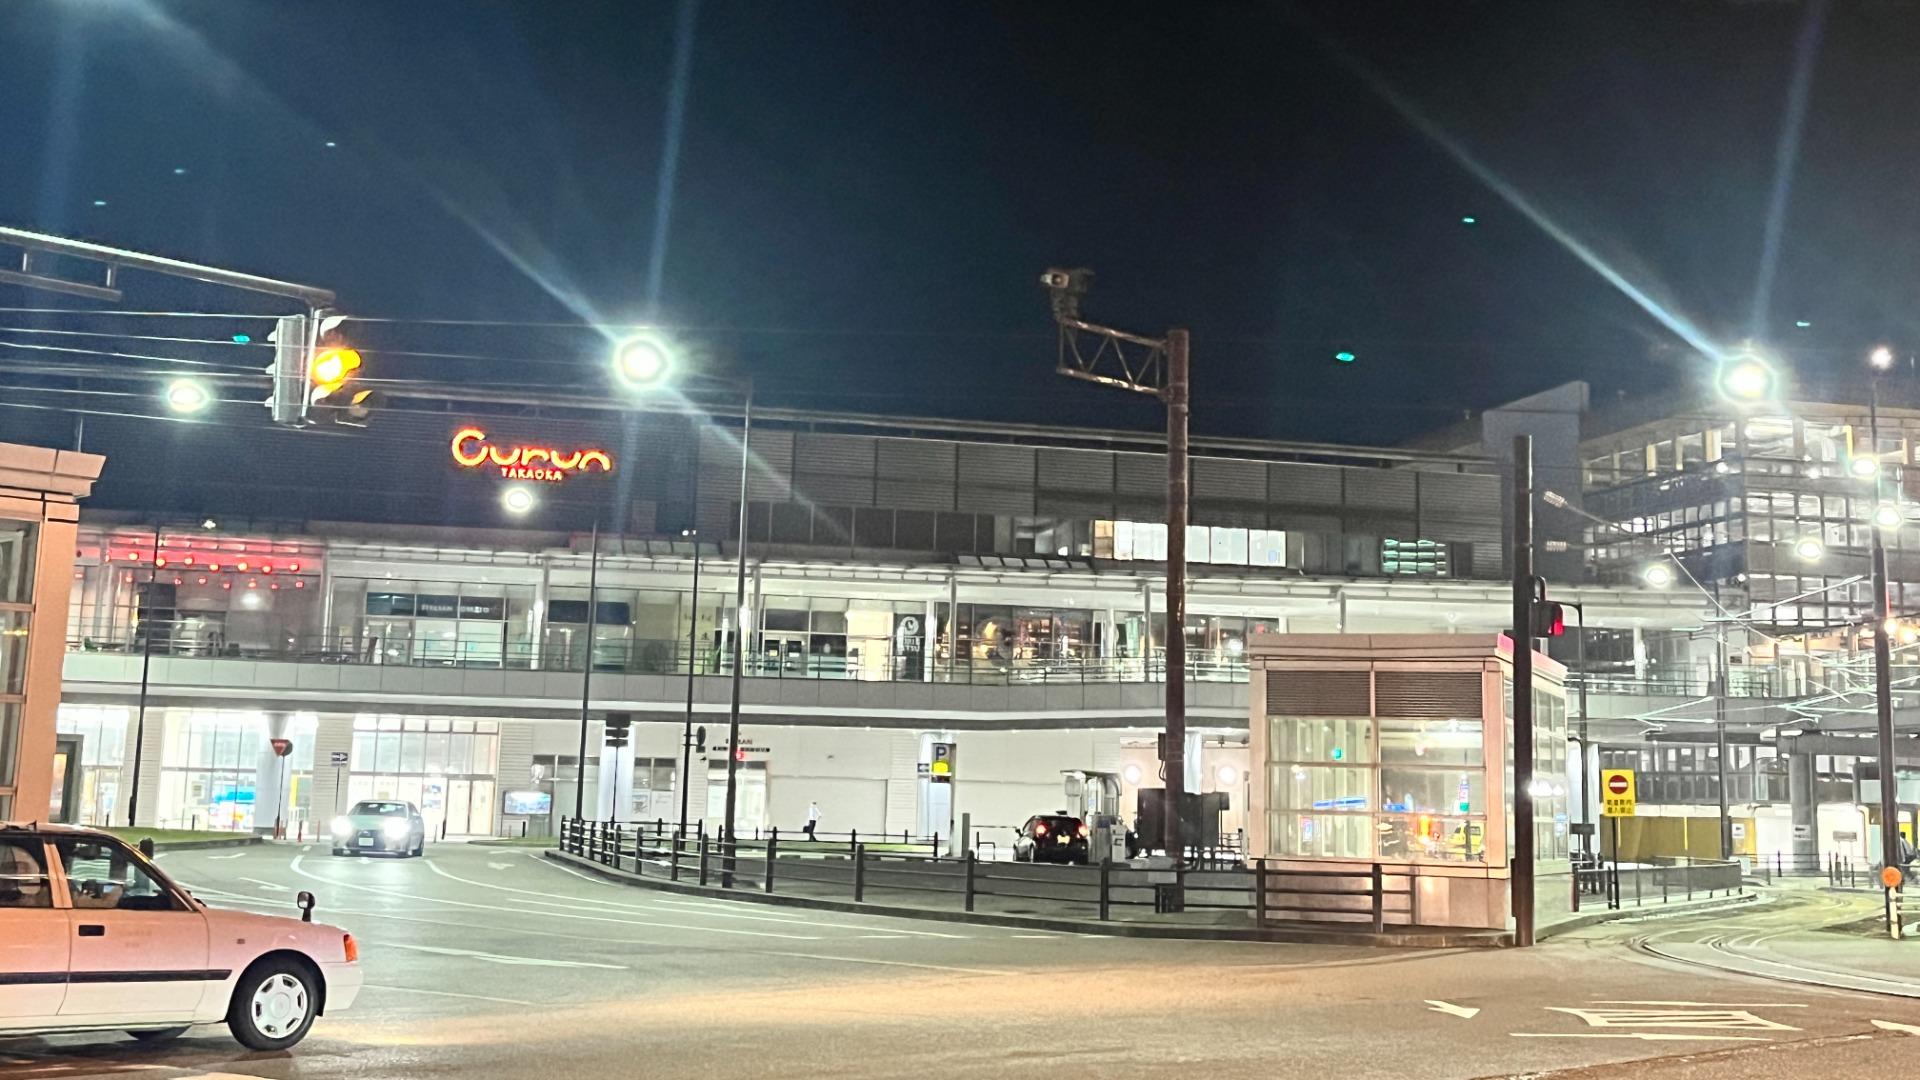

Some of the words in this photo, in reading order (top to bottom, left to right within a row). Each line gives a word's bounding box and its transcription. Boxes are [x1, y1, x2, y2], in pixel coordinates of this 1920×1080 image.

[451, 428, 612, 472] Curun
[501, 467, 563, 481] TAKAOKA
[936, 746, 948, 761] P
